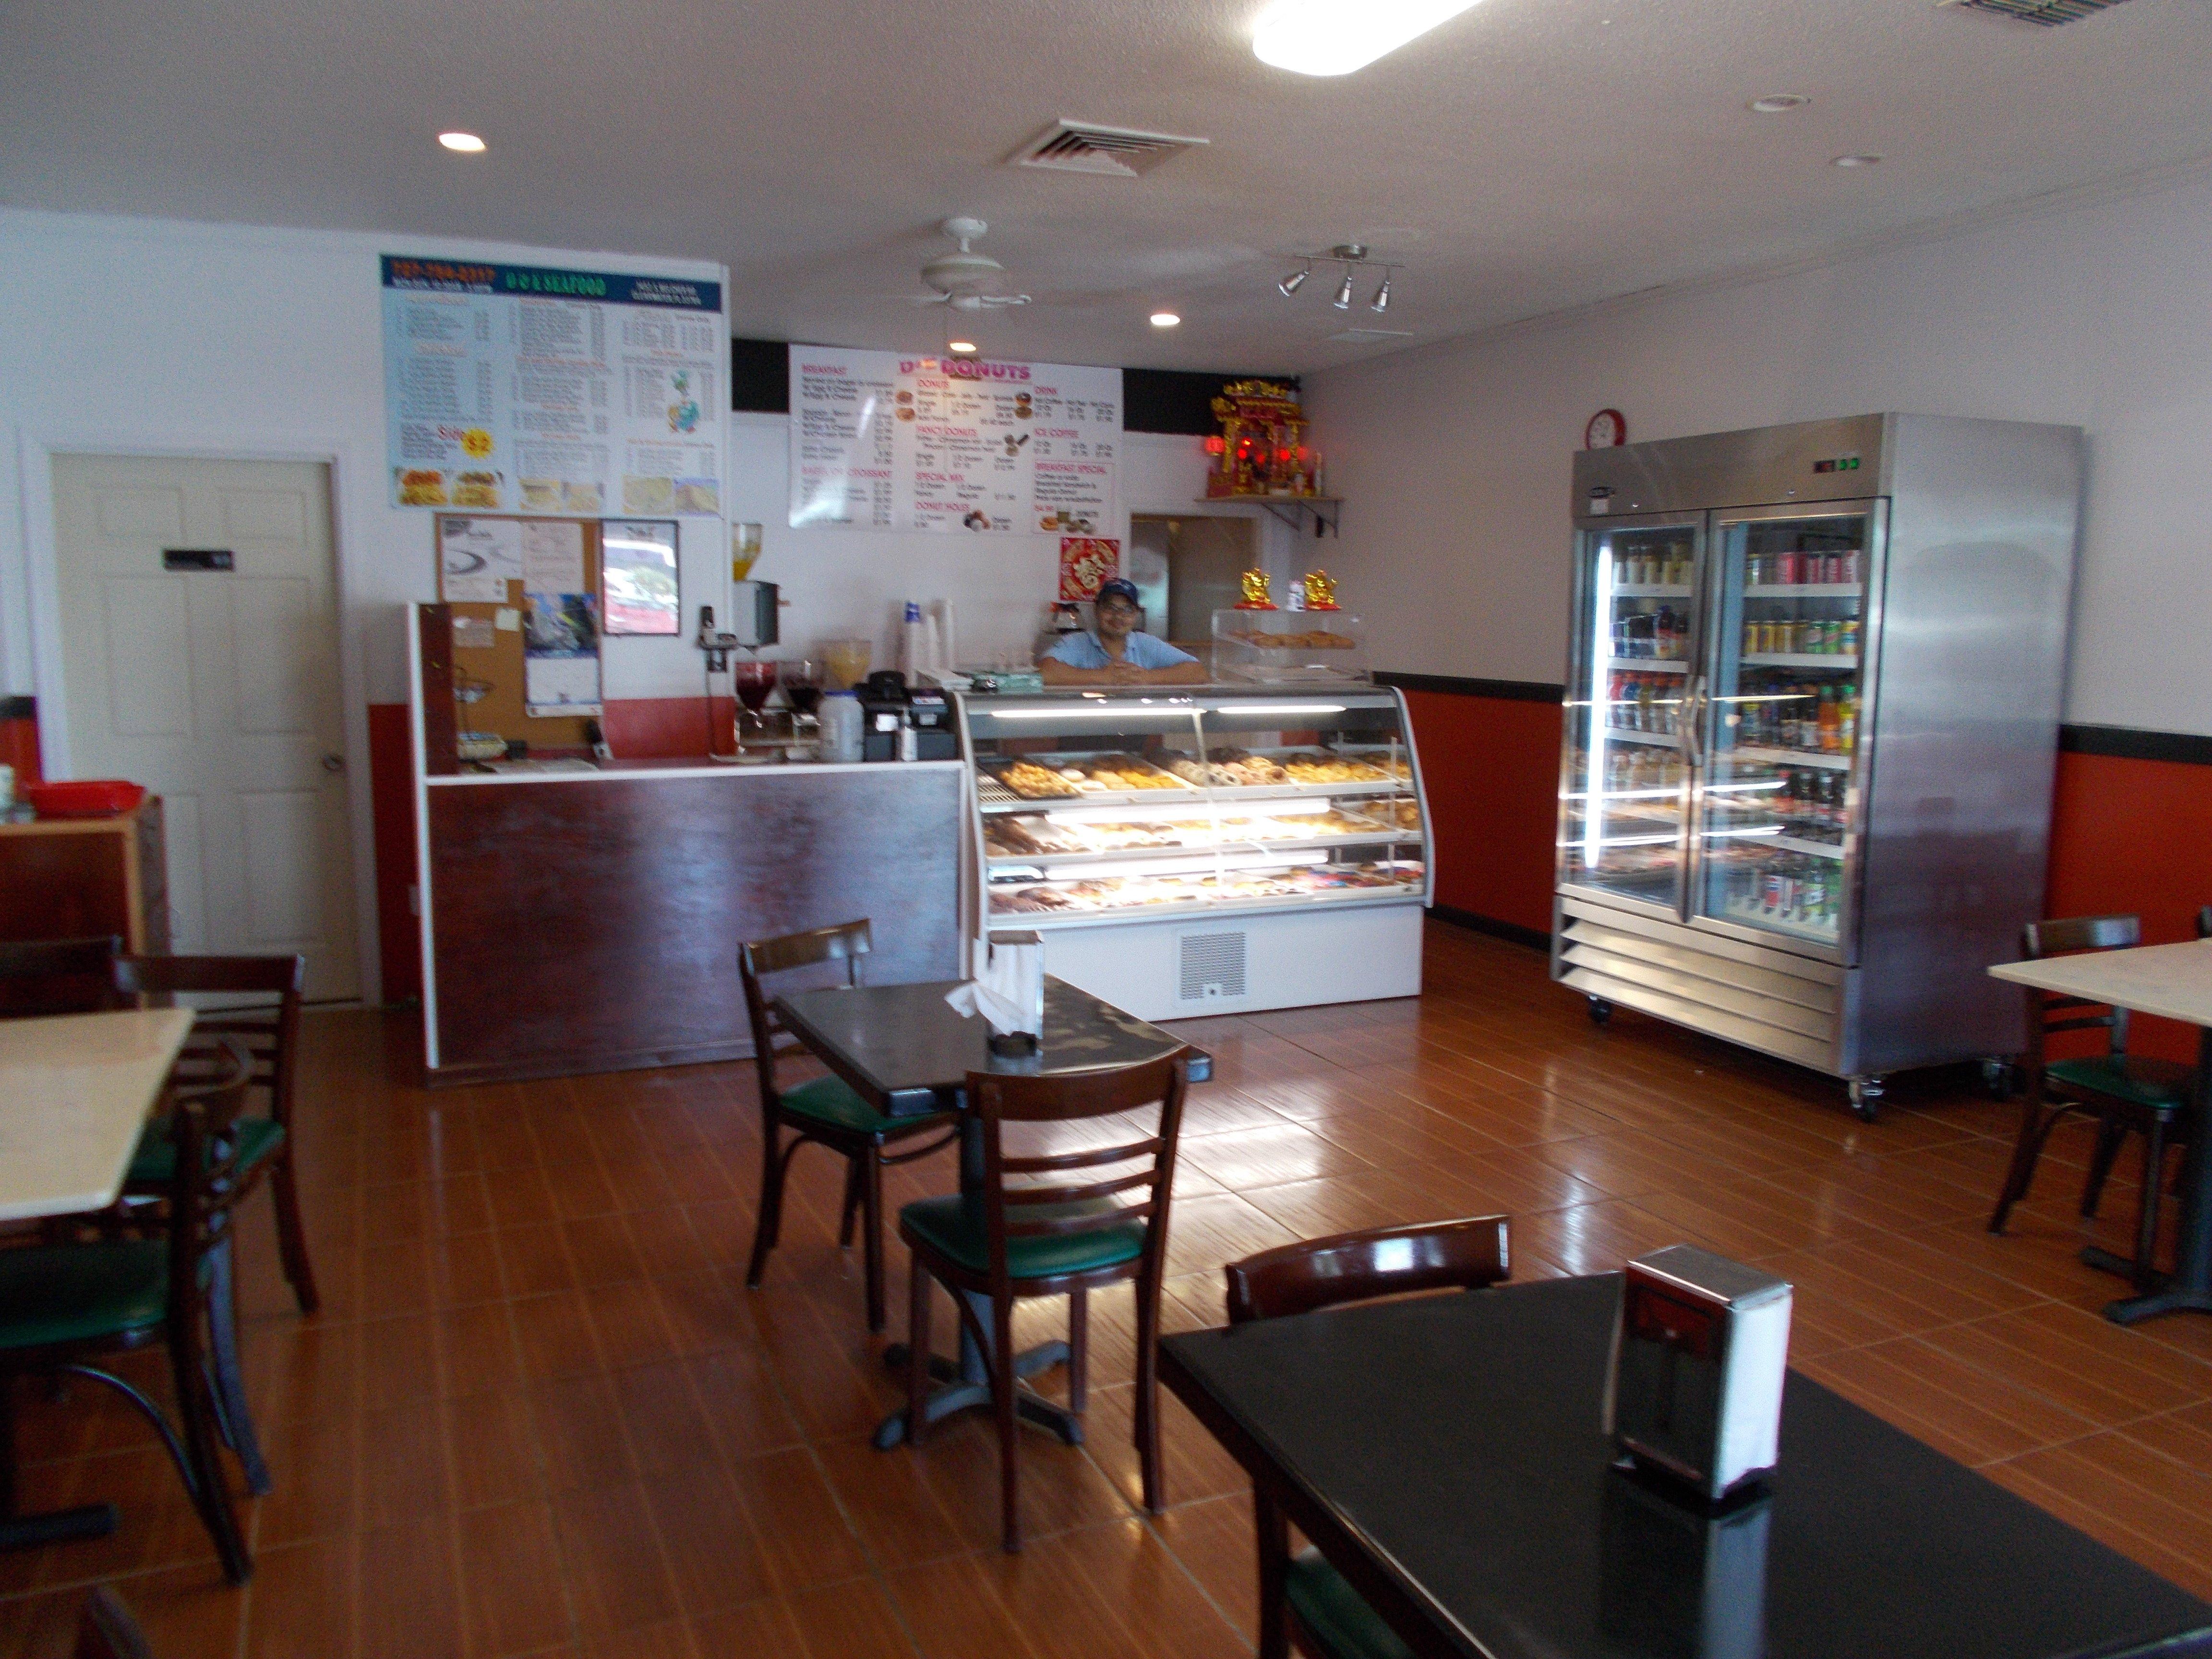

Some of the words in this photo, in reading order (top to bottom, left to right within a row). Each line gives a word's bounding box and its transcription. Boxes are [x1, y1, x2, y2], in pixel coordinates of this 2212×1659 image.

[544, 274, 606, 295] SEAFOOD
[802, 364, 846, 375] BREAKFAST
[941, 358, 1031, 380] DONUTS
[918, 379, 950, 389] DONUTS
[1034, 386, 1057, 395] DRINK
[945, 427, 978, 437] DONUTS
[1049, 429, 1079, 438] COFFEE
[847, 468, 893, 478] CROISSANT
[1034, 463, 1074, 473] BREAKFAST
[1077, 464, 1106, 474] SPECIAL
[915, 472, 947, 481] SPECIAL
[949, 473, 964, 482] MIX
[915, 502, 943, 511] DONUT
[945, 503, 970, 512] HOLES
